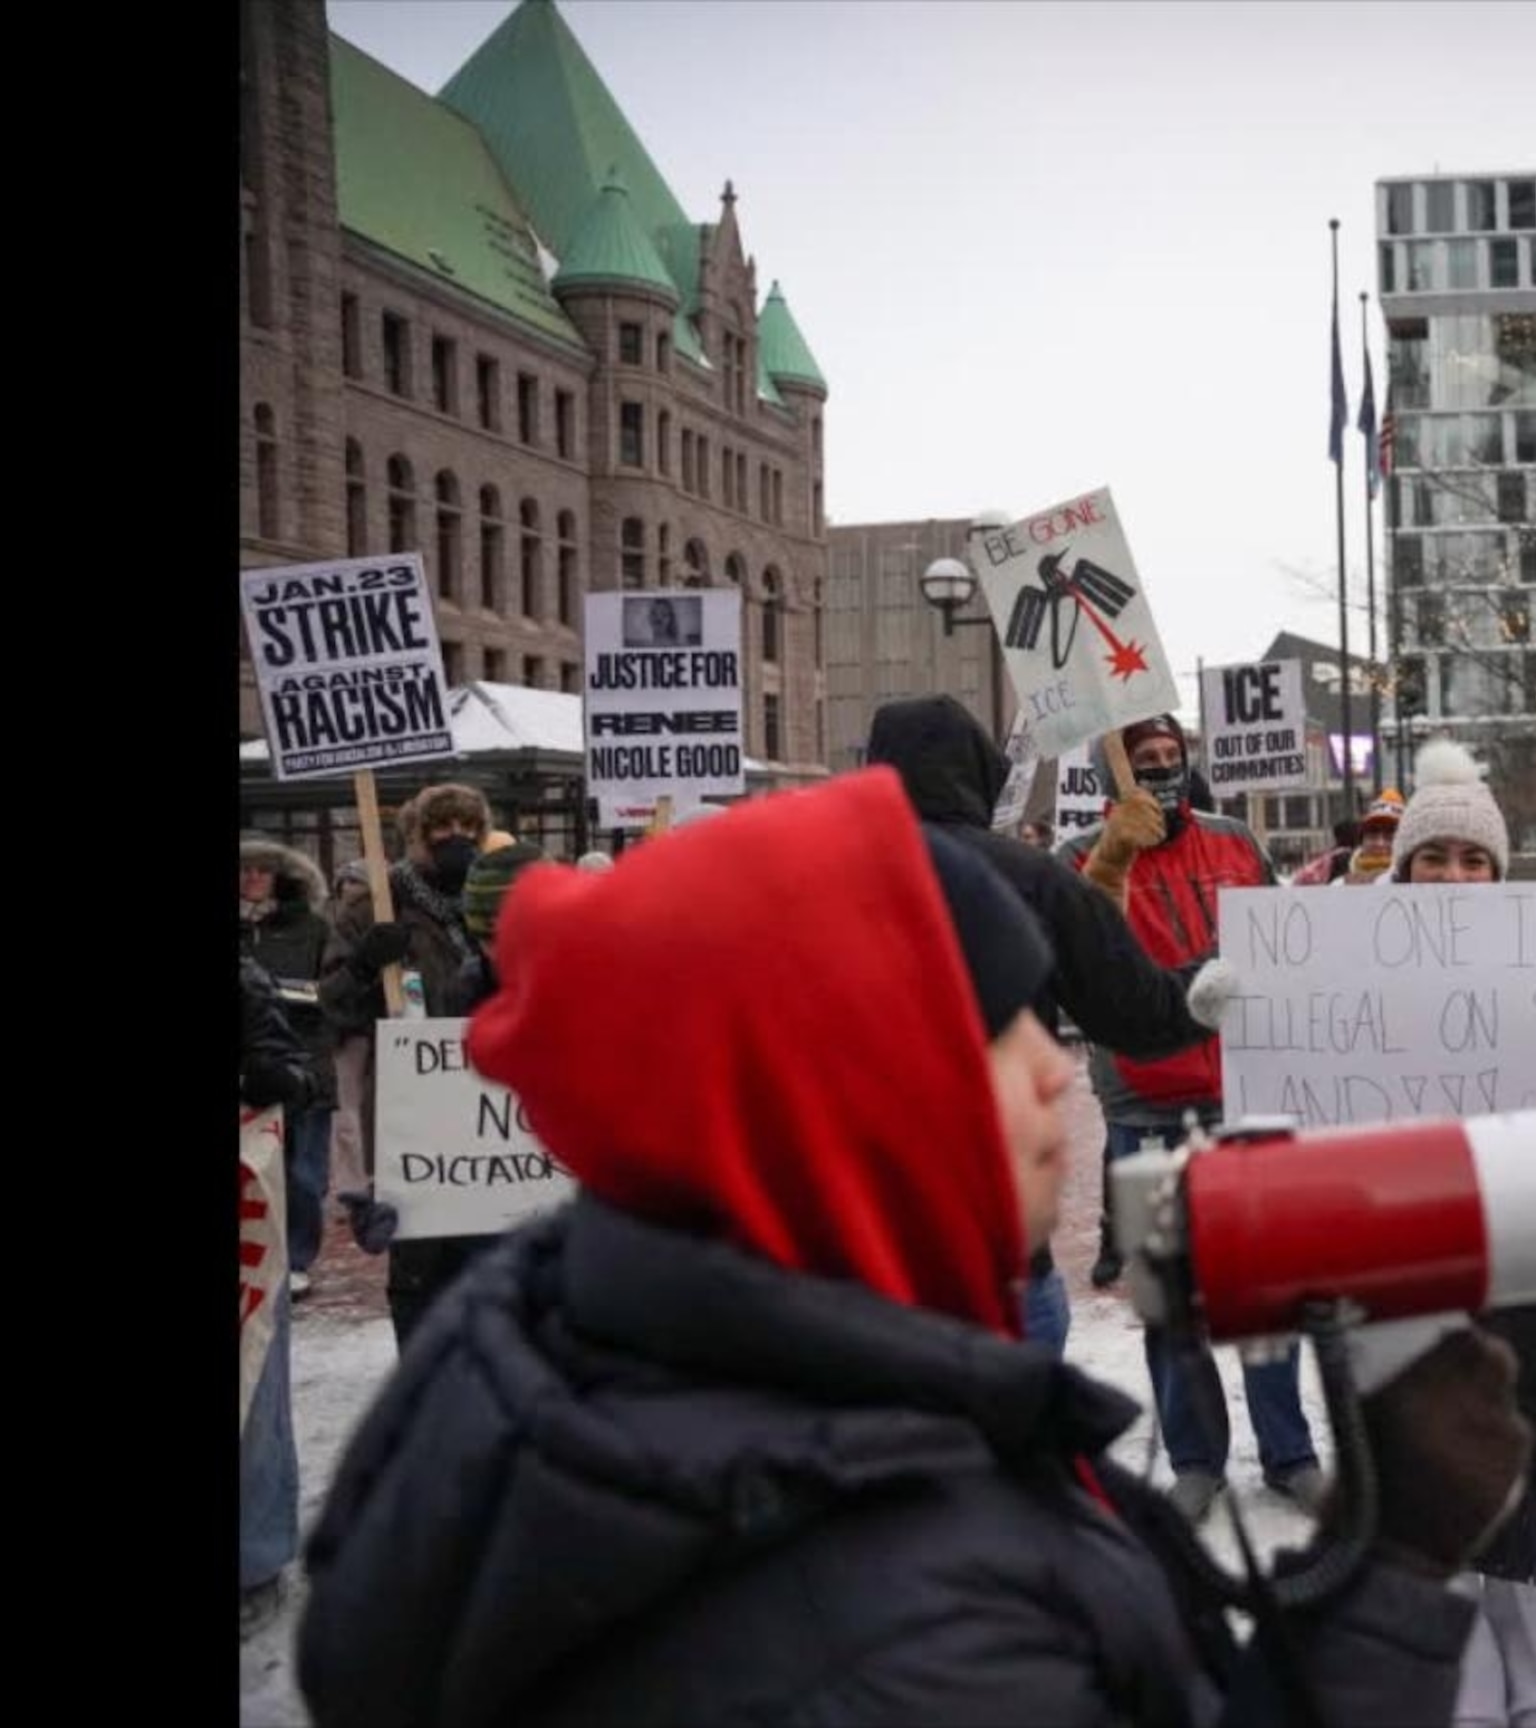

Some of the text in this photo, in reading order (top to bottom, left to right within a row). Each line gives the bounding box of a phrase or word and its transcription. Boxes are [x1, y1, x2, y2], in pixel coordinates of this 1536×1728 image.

[984, 499, 1107, 568] BE GONE
[252, 566, 416, 605] JAN.23
[257, 588, 430, 668] STRIKE
[280, 662, 426, 693] AGAINST
[589, 651, 738, 690] JUSTICE FOR
[270, 670, 445, 751] RACISM
[1030, 680, 1077, 721] ICE
[1223, 664, 1283, 725] ICE
[590, 710, 738, 737] RENEE
[590, 743, 740, 781] NICOLE GOOD
[1214, 729, 1296, 759] OUT OF OUR
[1211, 753, 1305, 784] COMMUNITIES
[1246, 899, 1313, 969] NO
[1372, 895, 1472, 971] ONE
[1224, 988, 1408, 1055] ILLEGAL
[1438, 992, 1500, 1054] ON
[394, 1037, 469, 1075] "DE
